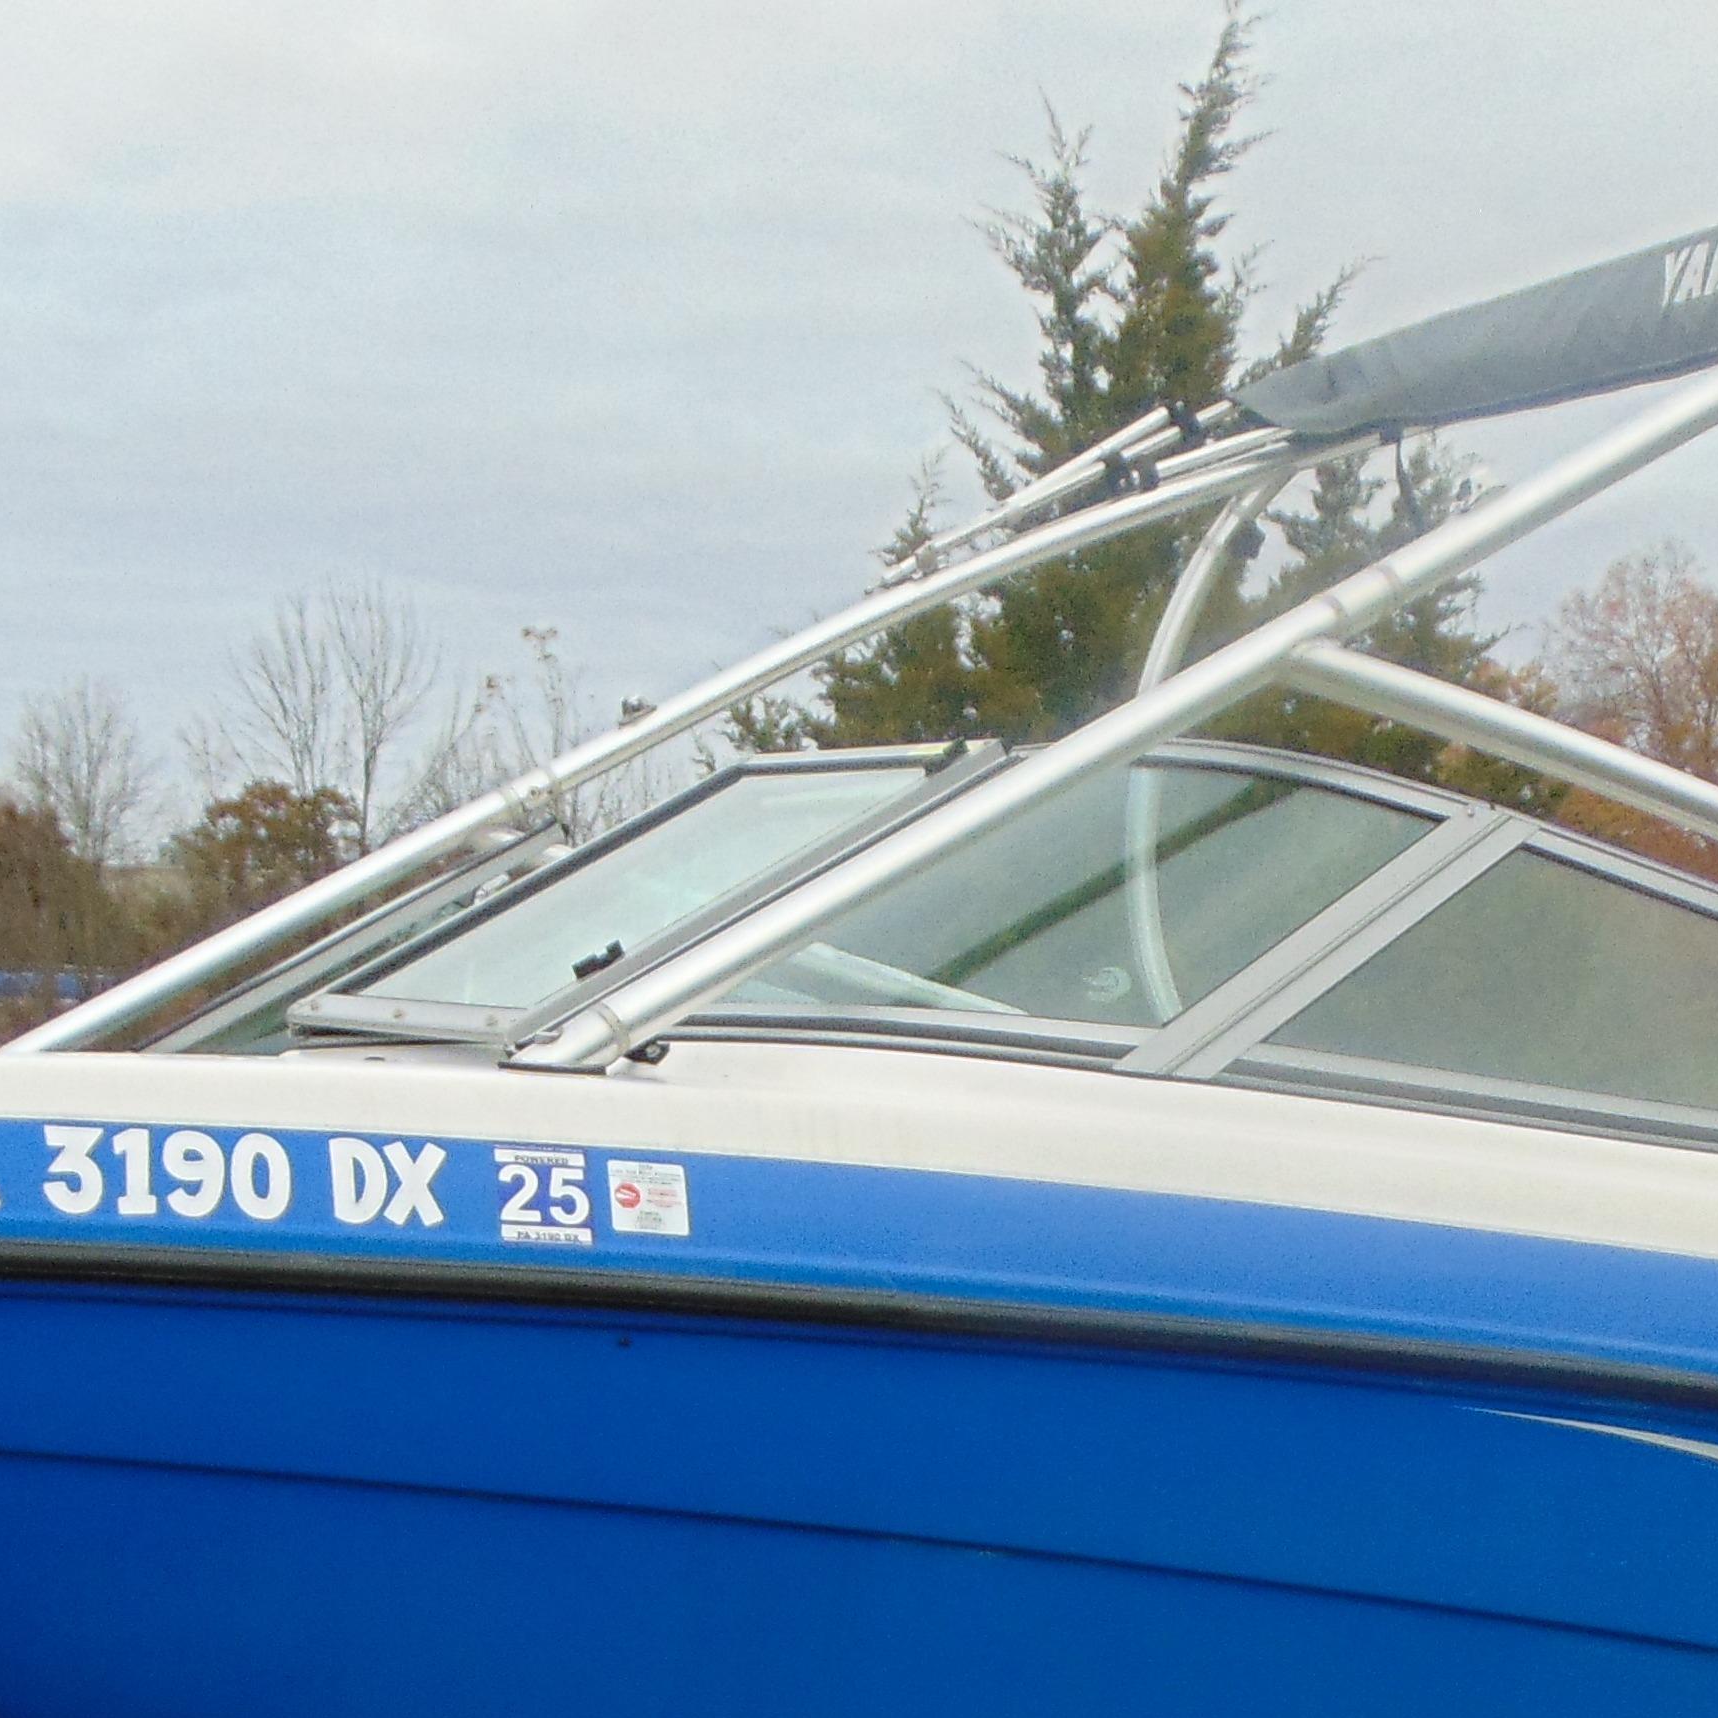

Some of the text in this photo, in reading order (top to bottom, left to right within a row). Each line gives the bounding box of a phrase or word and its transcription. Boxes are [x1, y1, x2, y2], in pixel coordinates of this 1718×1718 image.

[42, 1124, 291, 1220] 3190
[330, 1136, 447, 1227] DX
[498, 1164, 590, 1225] 25
